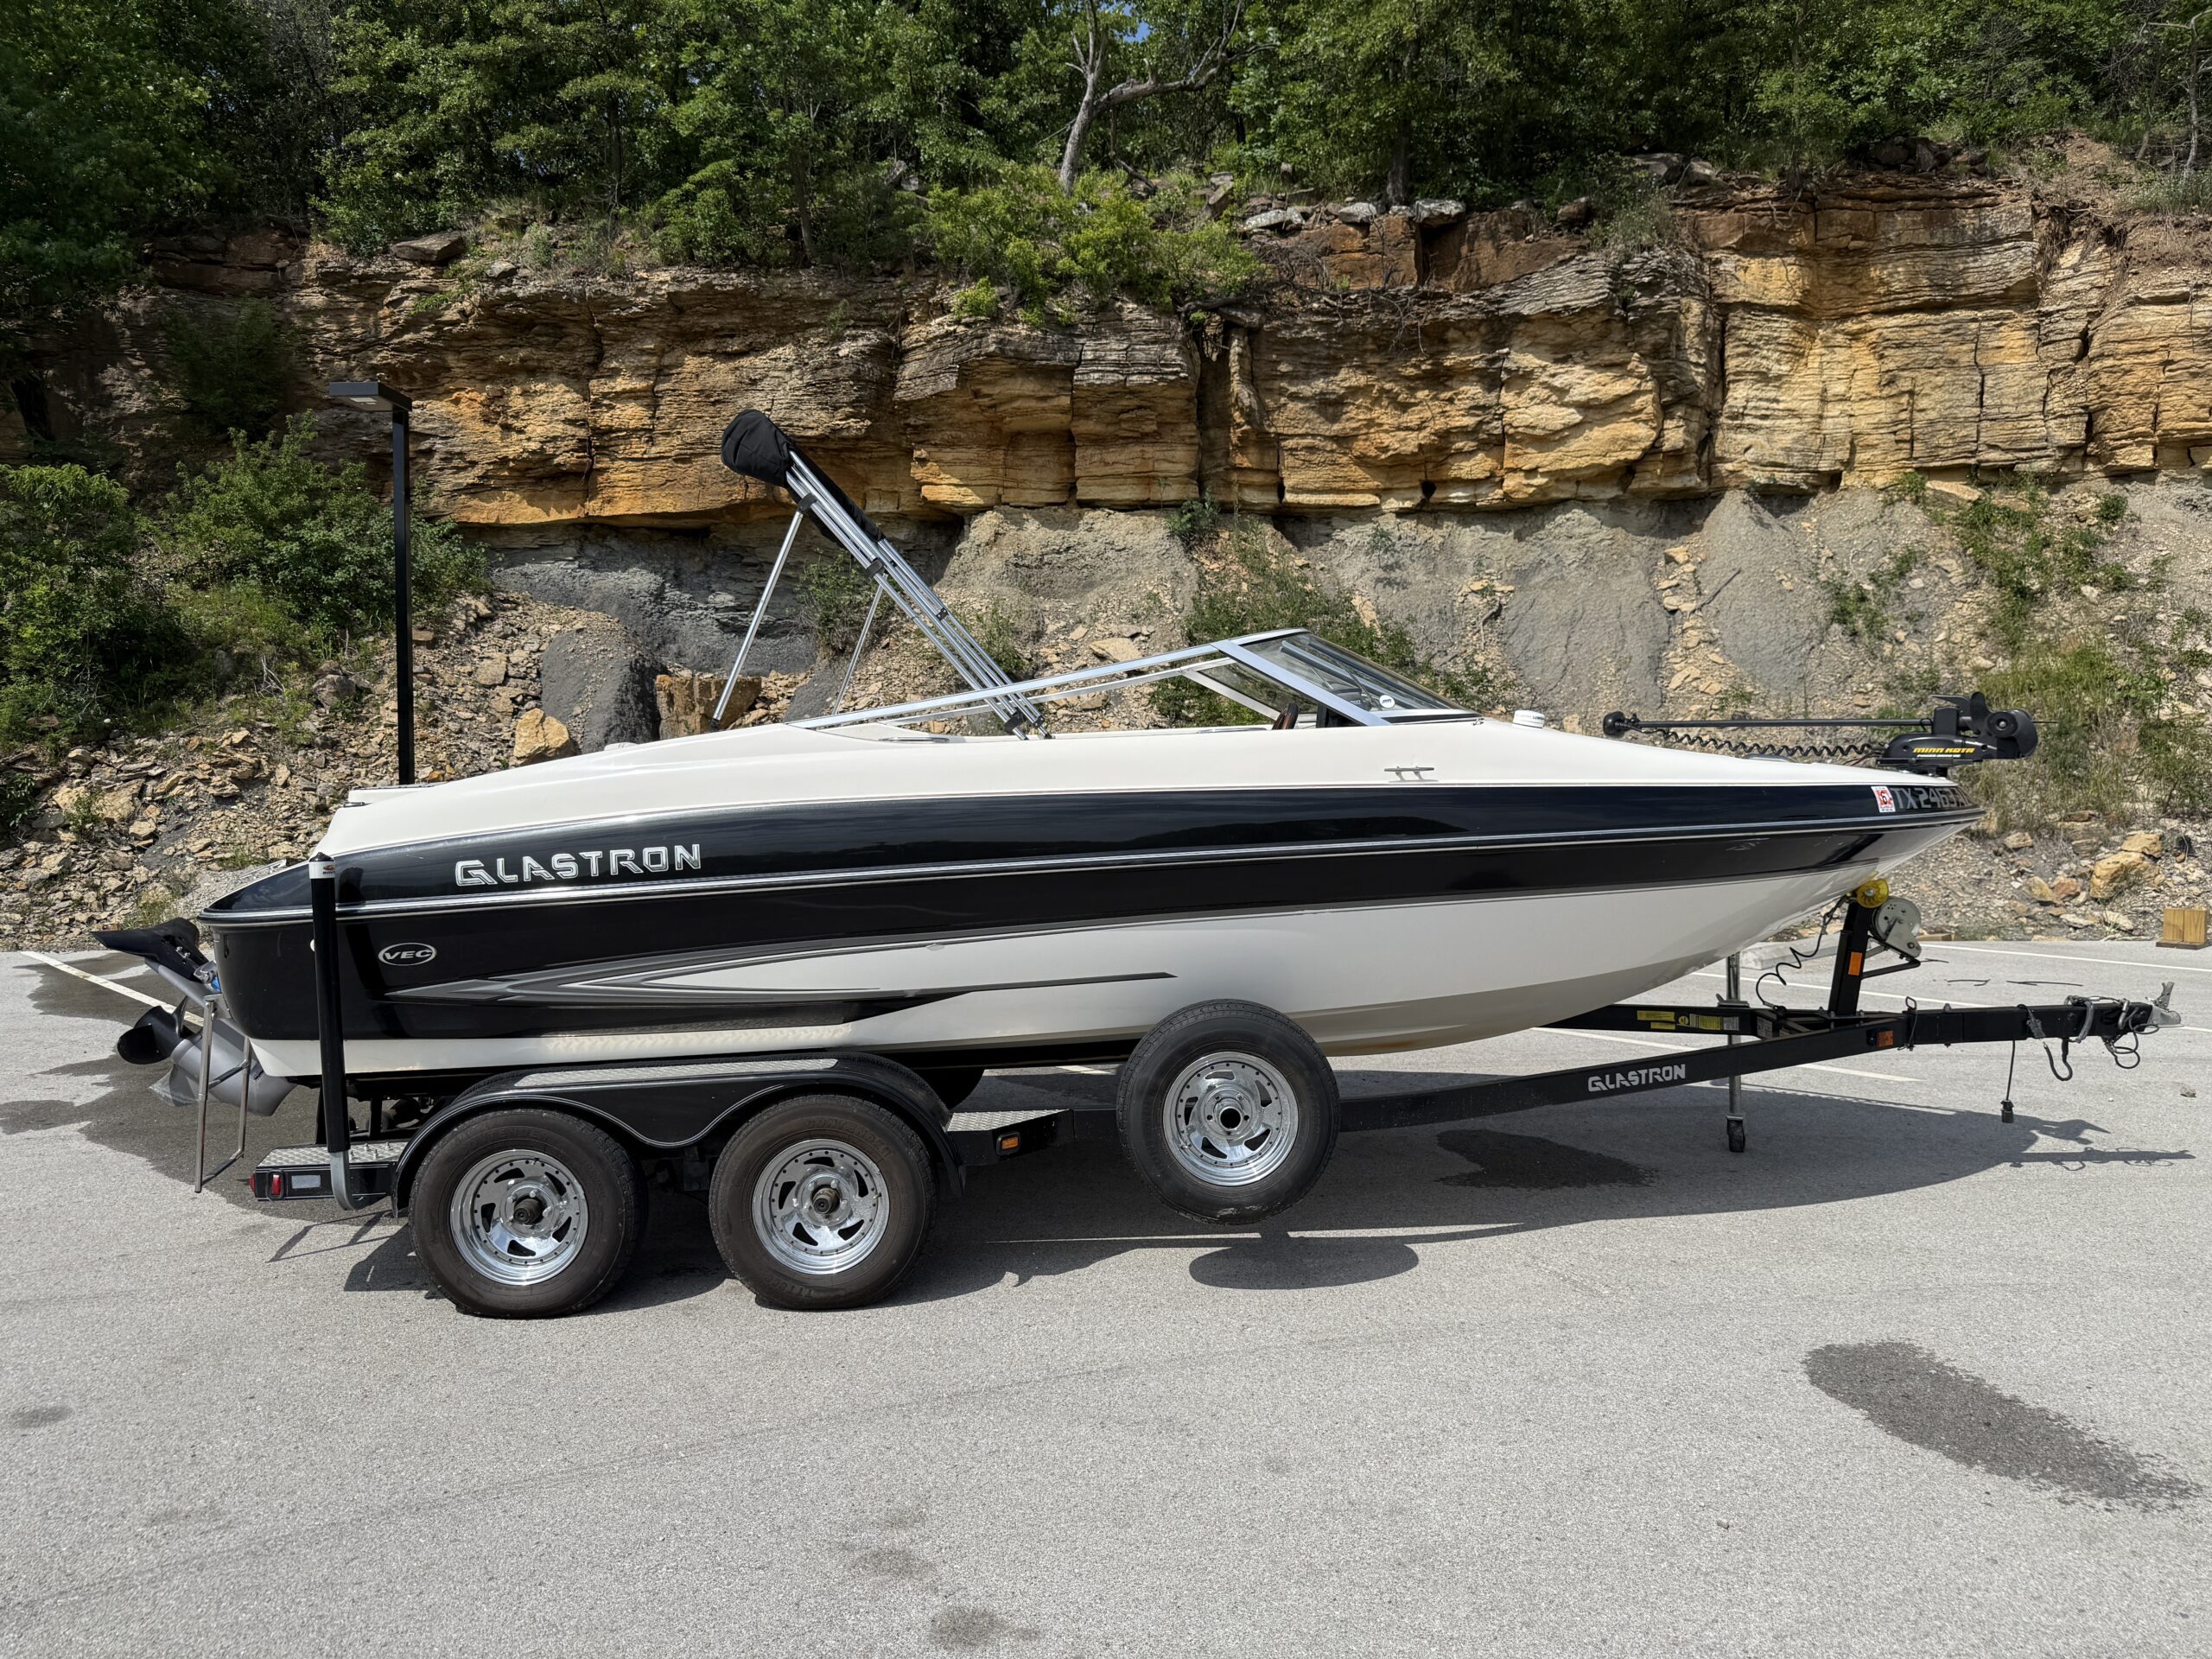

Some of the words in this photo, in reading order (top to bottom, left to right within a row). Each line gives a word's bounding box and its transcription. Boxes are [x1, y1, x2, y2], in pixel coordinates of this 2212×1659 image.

[1890, 787, 1918, 810] TX
[454, 843, 702, 887] GLASTRON
[384, 949, 432, 961] VEC
[1587, 1064, 1687, 1092] GLASTRON
